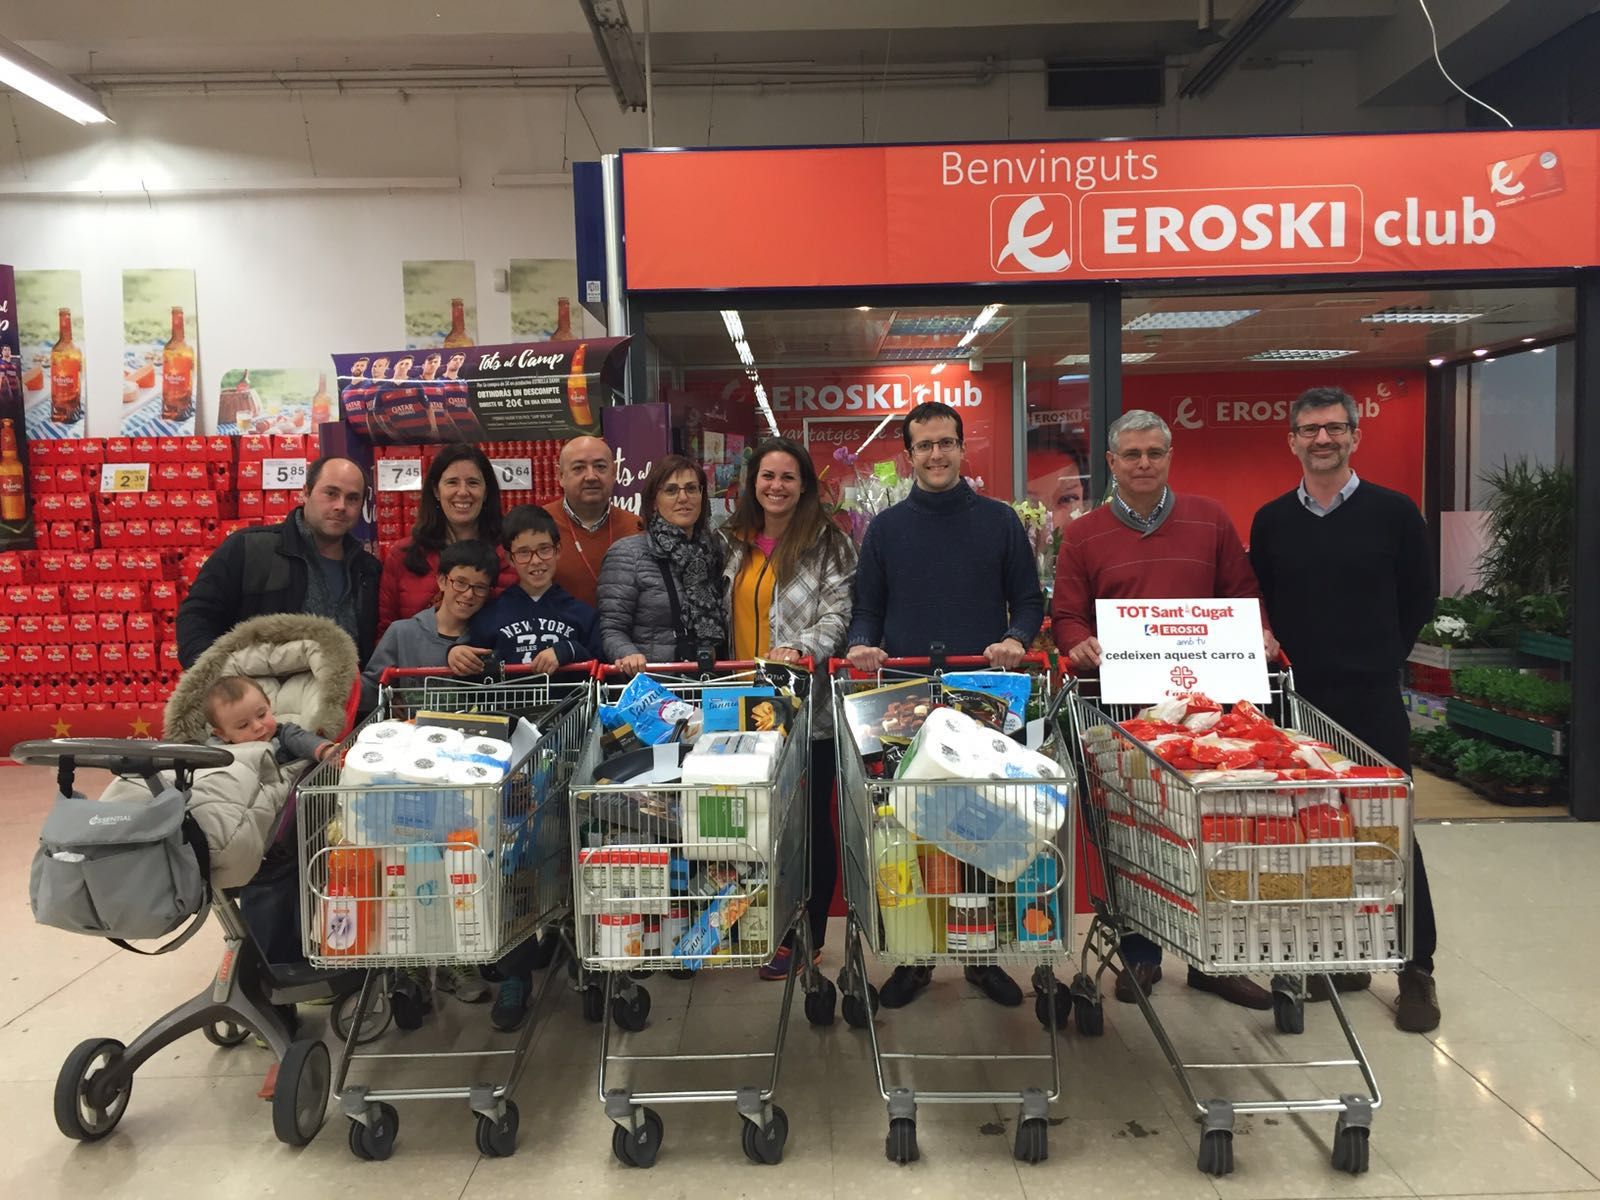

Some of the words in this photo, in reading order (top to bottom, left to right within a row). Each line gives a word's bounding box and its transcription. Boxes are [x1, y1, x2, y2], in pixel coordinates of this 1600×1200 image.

[942, 149, 1158, 191] Benvinguts
[1103, 201, 1345, 254] EROSKI
[1374, 197, 1496, 247] club
[479, 352, 501, 371] Tots
[504, 355, 517, 367] al
[518, 349, 564, 370] Camp
[523, 386, 560, 396] DESCOMPTE
[772, 383, 905, 412] EROSKI
[506, 399, 523, 408] 20€
[1217, 401, 1294, 421] EROS
[1117, 606, 1149, 618] TOT
[1151, 606, 1184, 618] Sant
[1191, 605, 1234, 620] Cugat
[500, 620, 533, 638] NEW
[538, 618, 575, 638] YORK
[1162, 625, 1206, 634] EROSKI
[1106, 650, 1161, 660] cedeixen
[1164, 650, 1207, 661] aquest
[1211, 652, 1244, 660] carro
[1248, 652, 1256, 660] a
